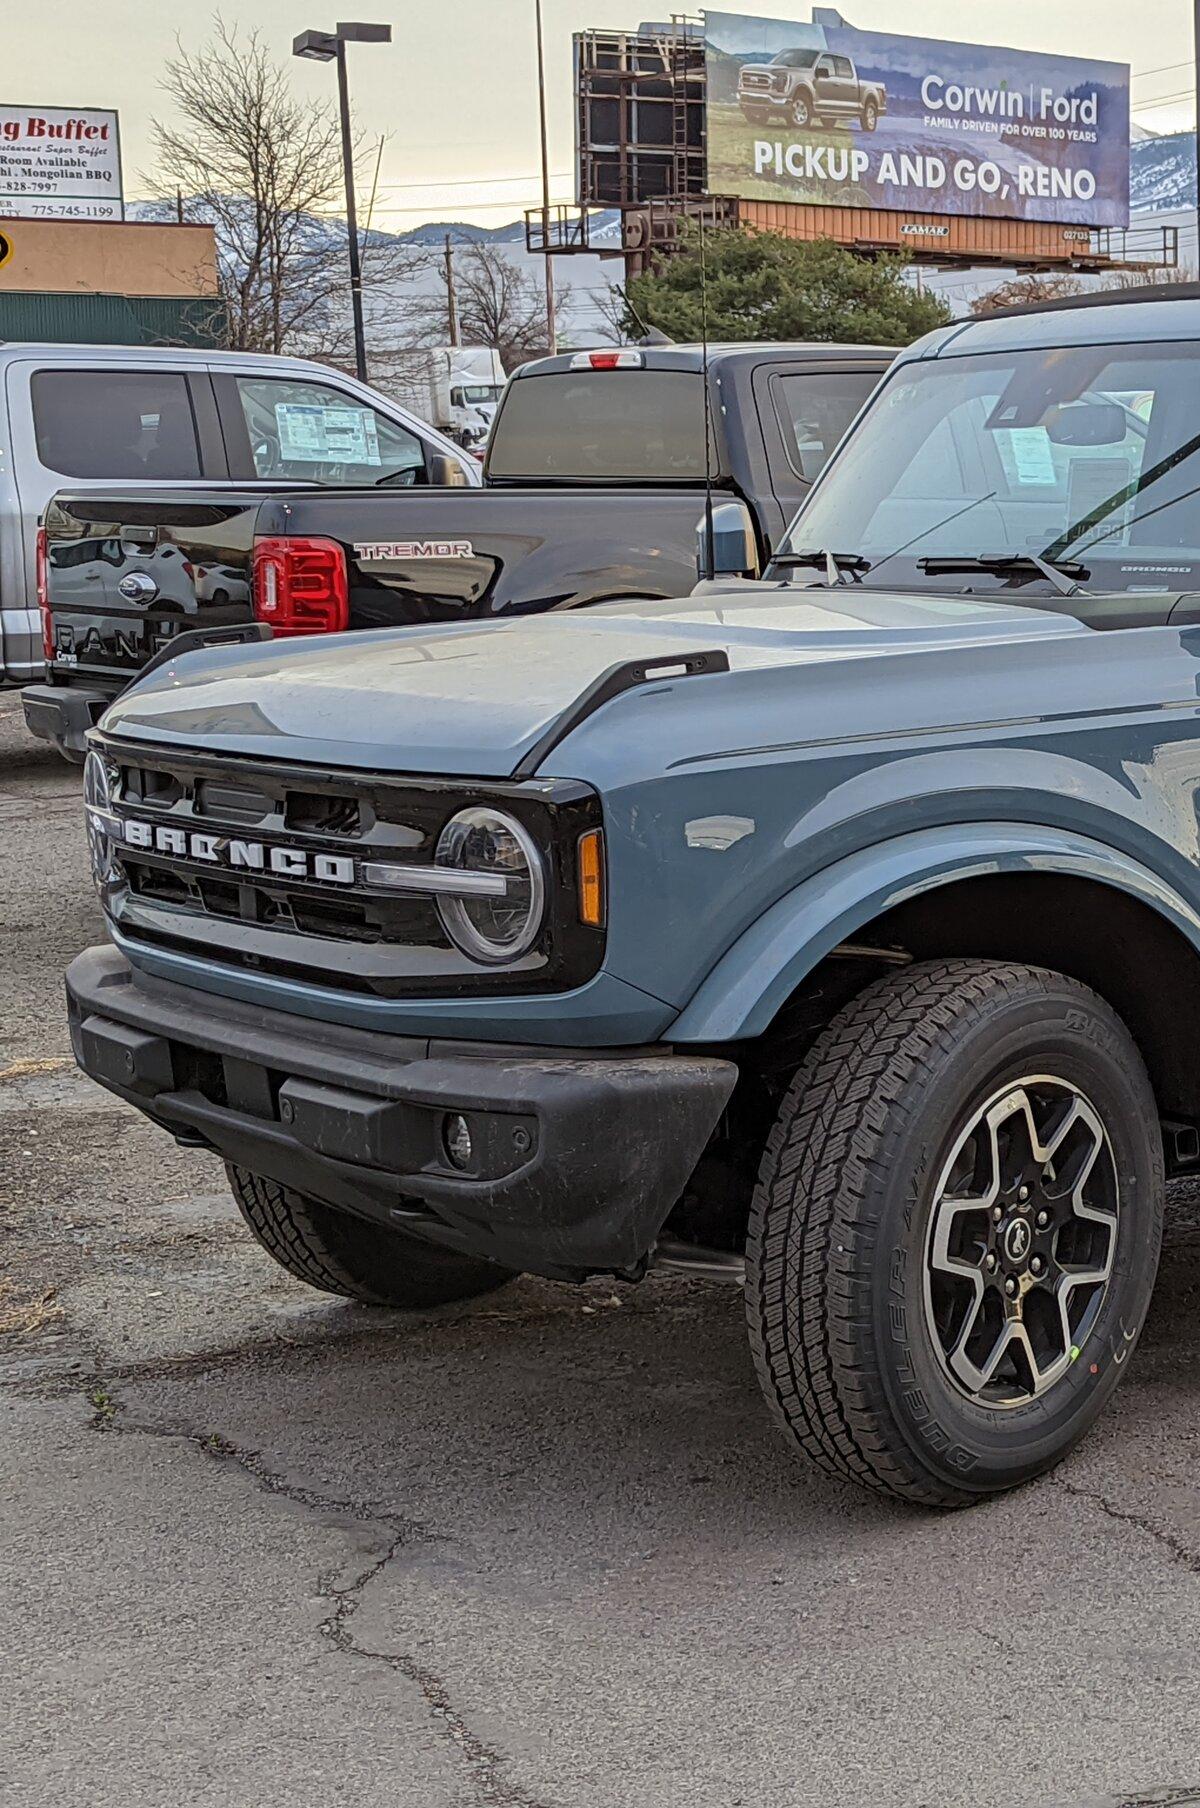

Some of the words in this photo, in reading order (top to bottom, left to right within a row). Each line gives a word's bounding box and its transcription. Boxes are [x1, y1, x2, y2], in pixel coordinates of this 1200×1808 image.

[921, 75, 1023, 118] Corwin
[1041, 87, 1097, 125] Ford
[26, 117, 109, 140] Buffet
[924, 116, 961, 130] FAMILY
[962, 120, 998, 133] DRIVEN
[1000, 123, 1019, 135] FOR
[1021, 126, 1046, 138] OVER
[1049, 128, 1065, 140] 100
[1067, 130, 1097, 143] YEARS
[45, 144, 73, 156] Super
[78, 145, 107, 157] Buffet
[0, 155, 32, 166] Room
[35, 157, 87, 168] Available
[754, 140, 869, 182] PICKUP
[877, 152, 946, 188] AND
[953, 159, 1010, 200] GO,
[1018, 165, 1096, 200] RENO
[21, 168, 82, 180] Mongolian
[86, 170, 112, 182] BBQ
[0, 182, 58, 192] -828-7997
[32, 205, 113, 217] 775-745-1199
[354, 541, 476, 560] TREMOR
[125, 819, 355, 884] BRONCO
